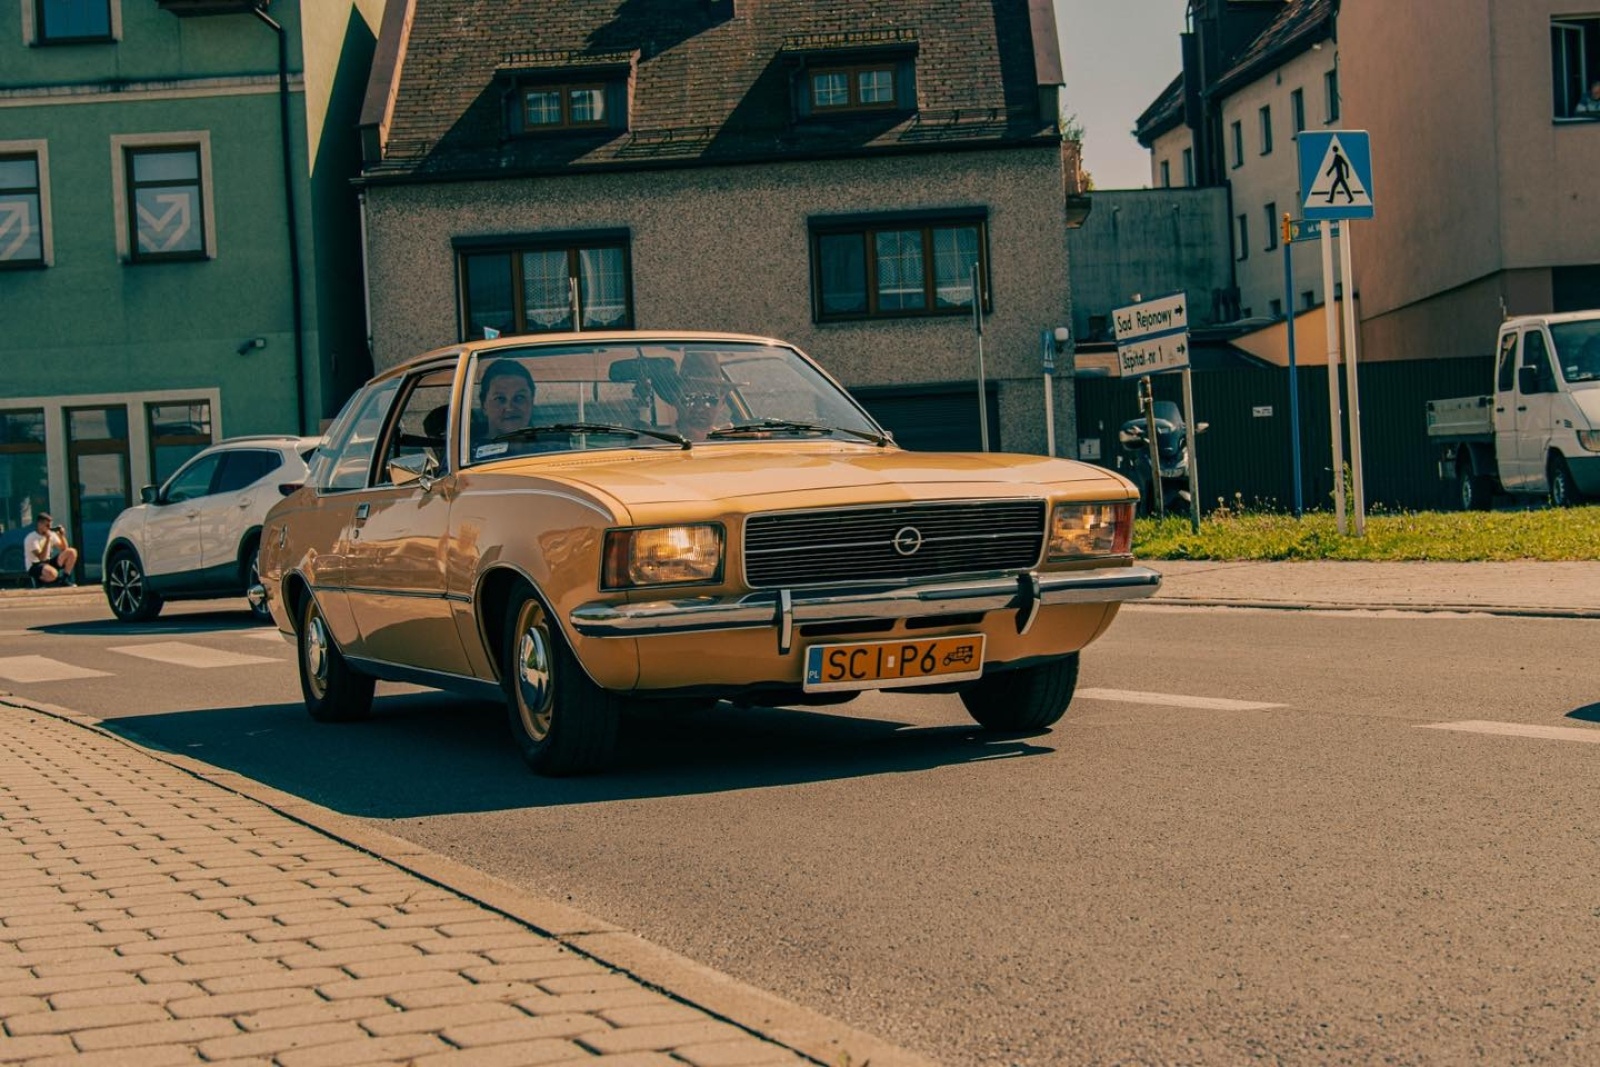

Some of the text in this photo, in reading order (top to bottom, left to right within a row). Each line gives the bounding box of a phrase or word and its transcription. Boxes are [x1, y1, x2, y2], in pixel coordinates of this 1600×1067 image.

[1136, 309, 1172, 331] Rejonowy
[829, 644, 936, 680] SCI P6
[808, 670, 820, 679] PL
